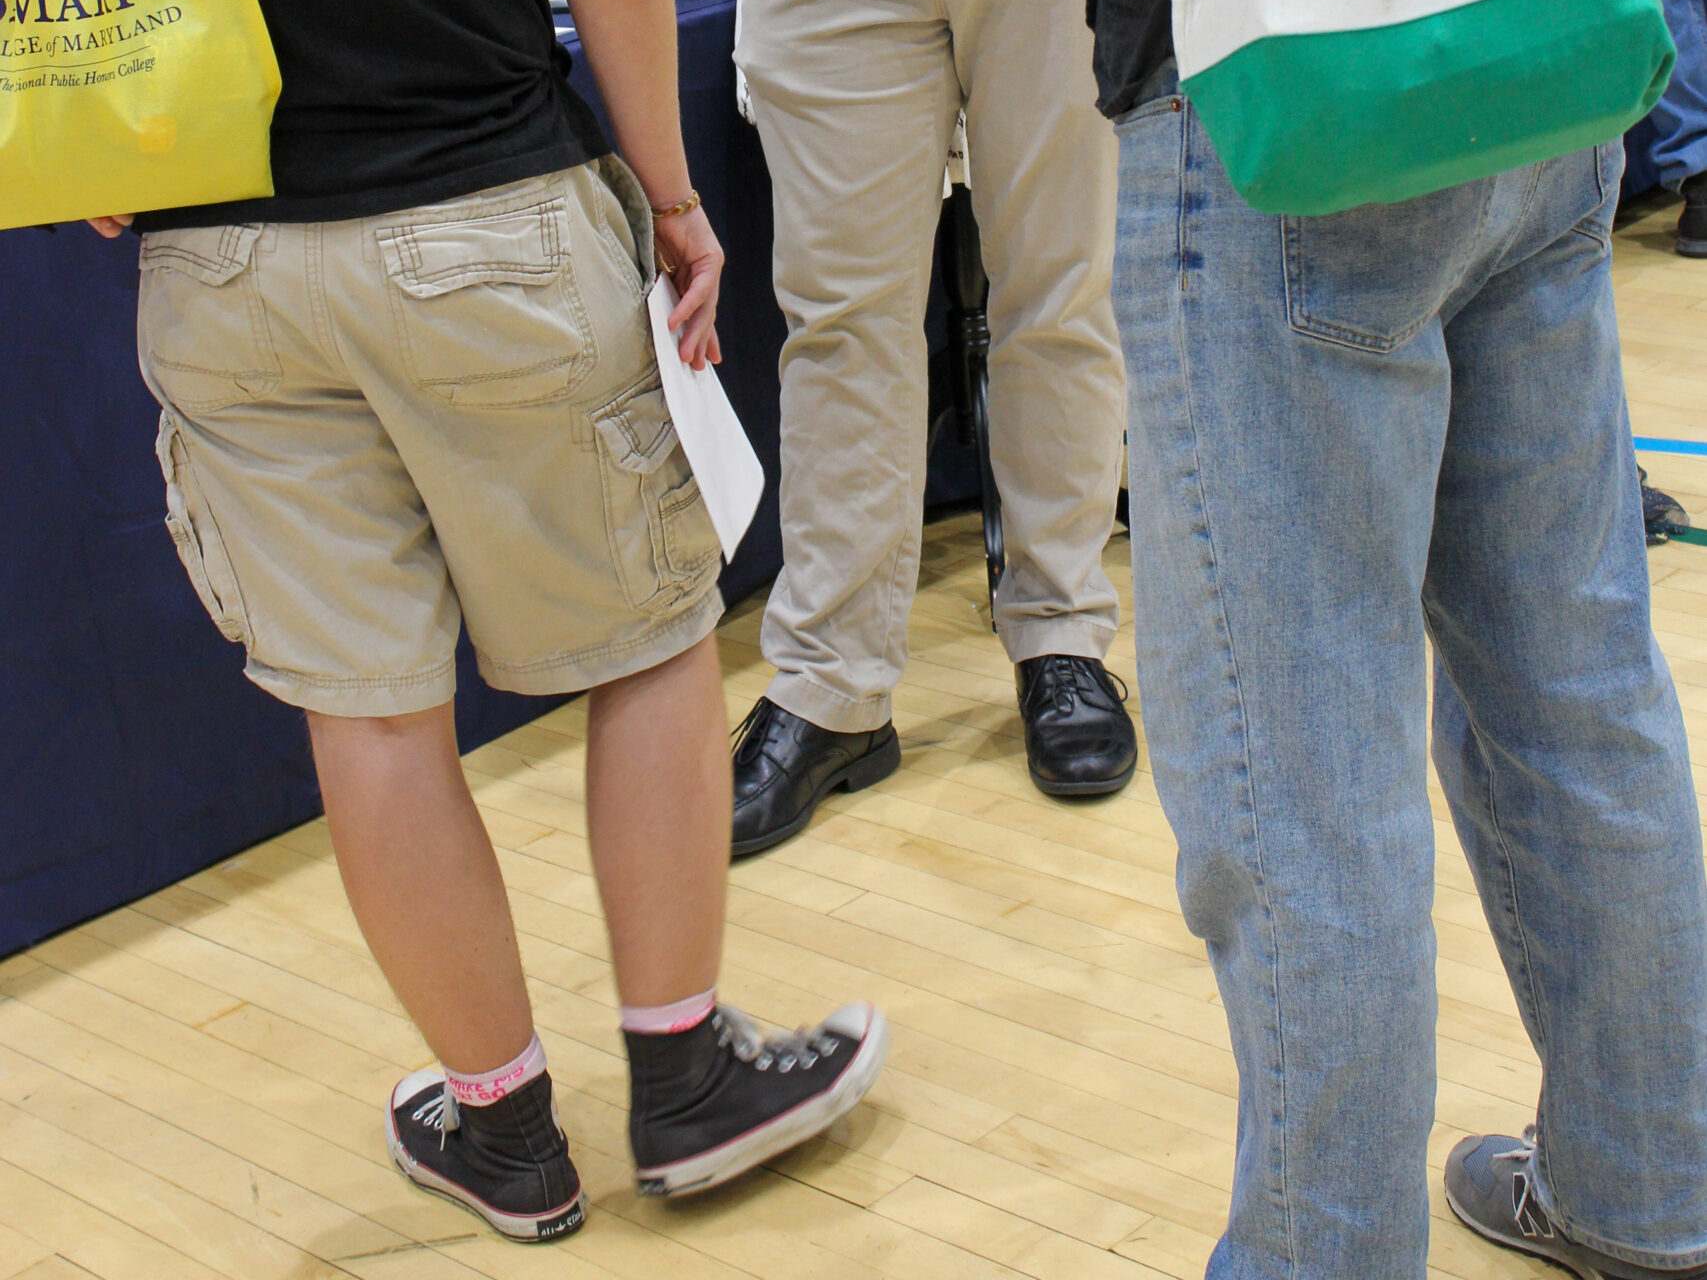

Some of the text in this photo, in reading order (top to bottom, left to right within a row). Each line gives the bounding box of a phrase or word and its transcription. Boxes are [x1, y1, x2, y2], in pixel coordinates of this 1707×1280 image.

[46, 35, 60, 57] of
[63, 6, 182, 53] MARYLAND
[50, 73, 81, 87] Public
[117, 57, 156, 77] College
